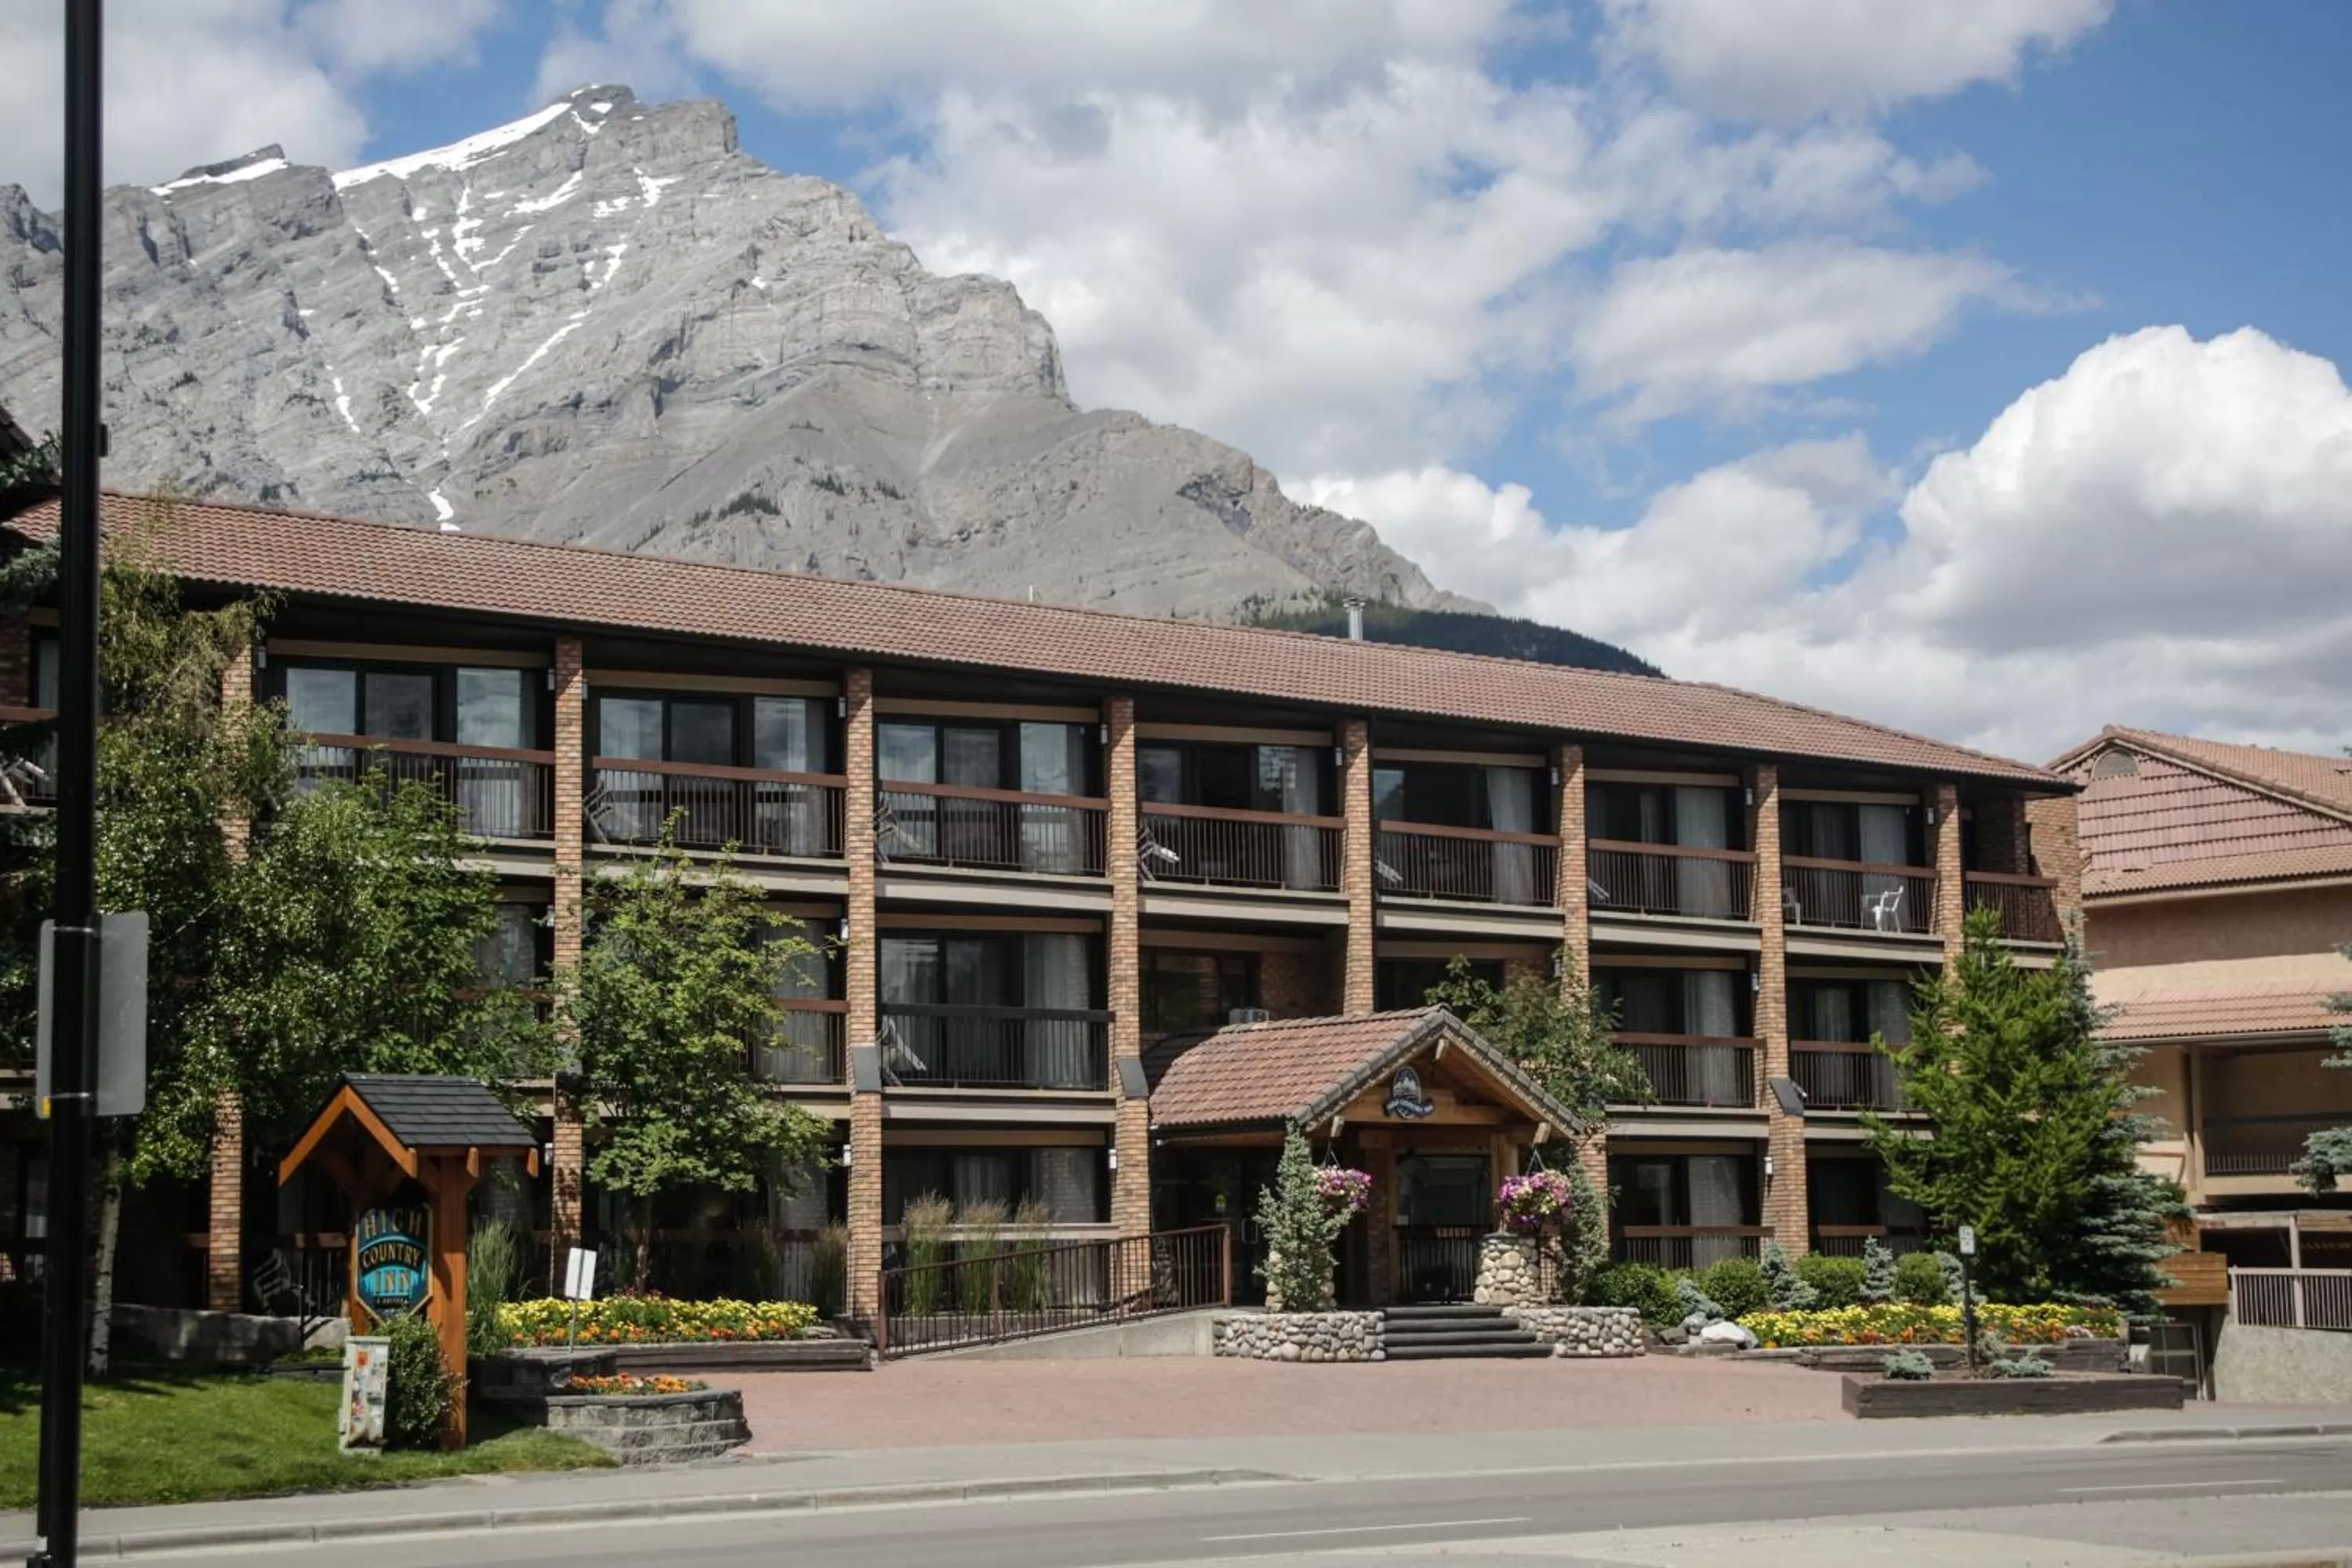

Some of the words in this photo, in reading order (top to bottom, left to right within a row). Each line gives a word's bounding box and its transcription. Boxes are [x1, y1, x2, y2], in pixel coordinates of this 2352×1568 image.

[364, 1208, 422, 1239] HIGH
[362, 1242, 421, 1268] COUNTRY
[376, 1269, 409, 1293] INN
